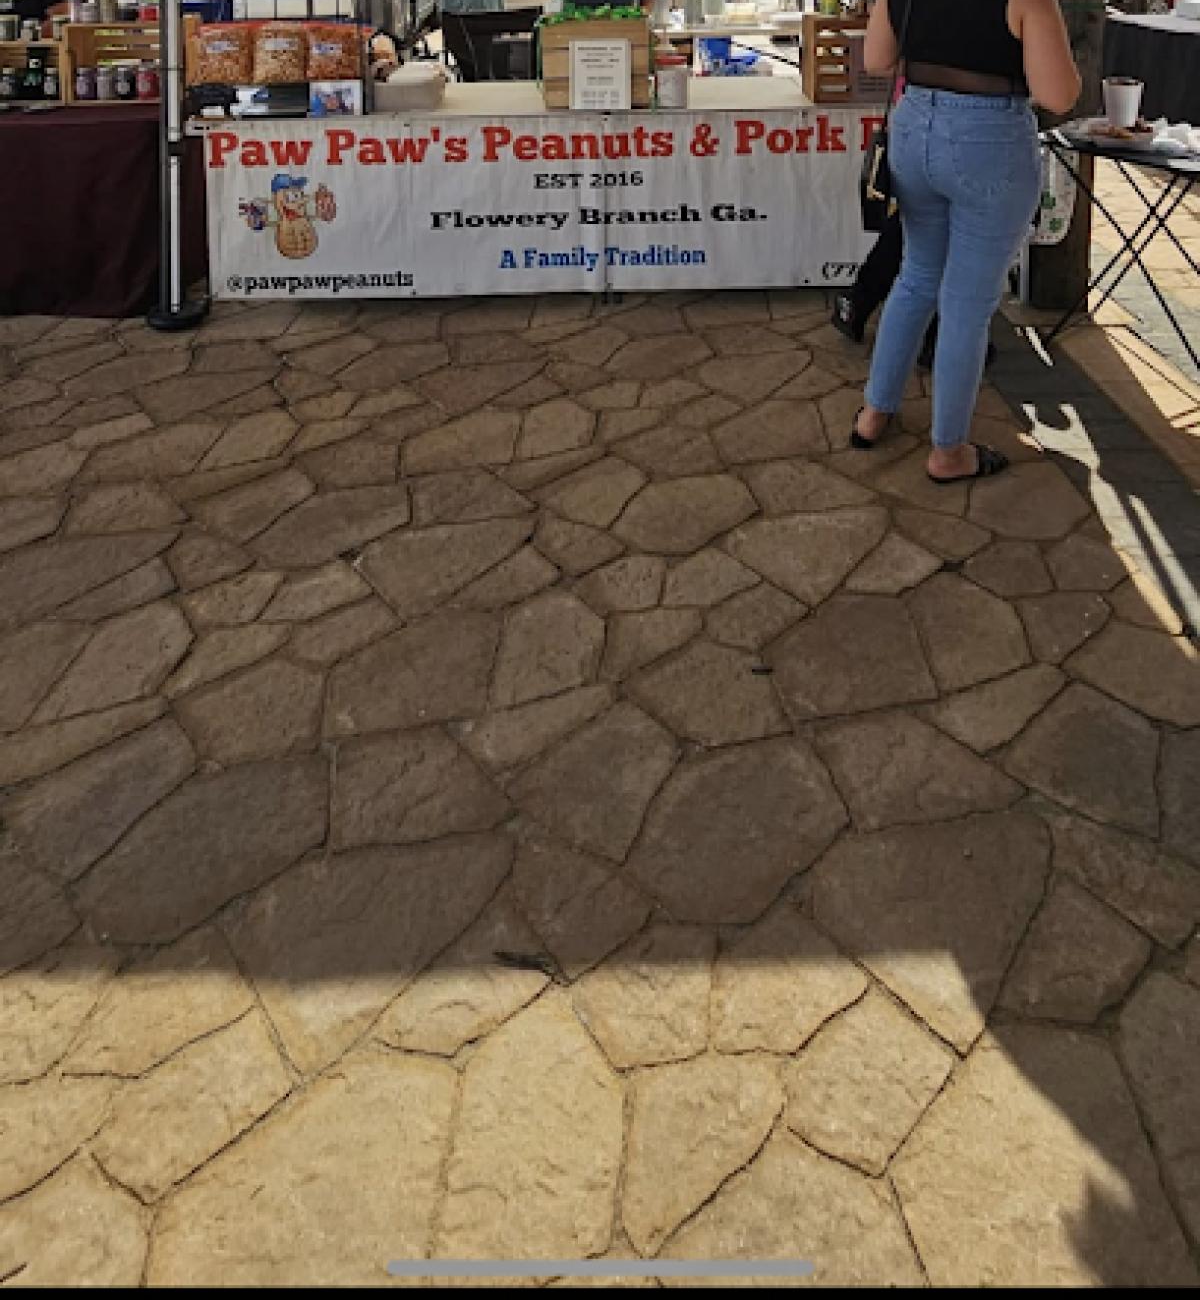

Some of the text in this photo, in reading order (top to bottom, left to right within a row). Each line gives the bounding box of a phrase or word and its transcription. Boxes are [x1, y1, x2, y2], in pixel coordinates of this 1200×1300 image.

[207, 131, 314, 168] Paw
[324, 126, 469, 165] Paw's
[480, 125, 674, 163] Peanuts
[690, 123, 720, 157] &
[734, 114, 847, 154] Pork
[533, 171, 644, 189] EST 2016
[430, 202, 769, 230] Flowery Branch Ga.
[499, 244, 708, 272] A Family Tradition
[226, 270, 414, 295] @pawpawpeanuts
